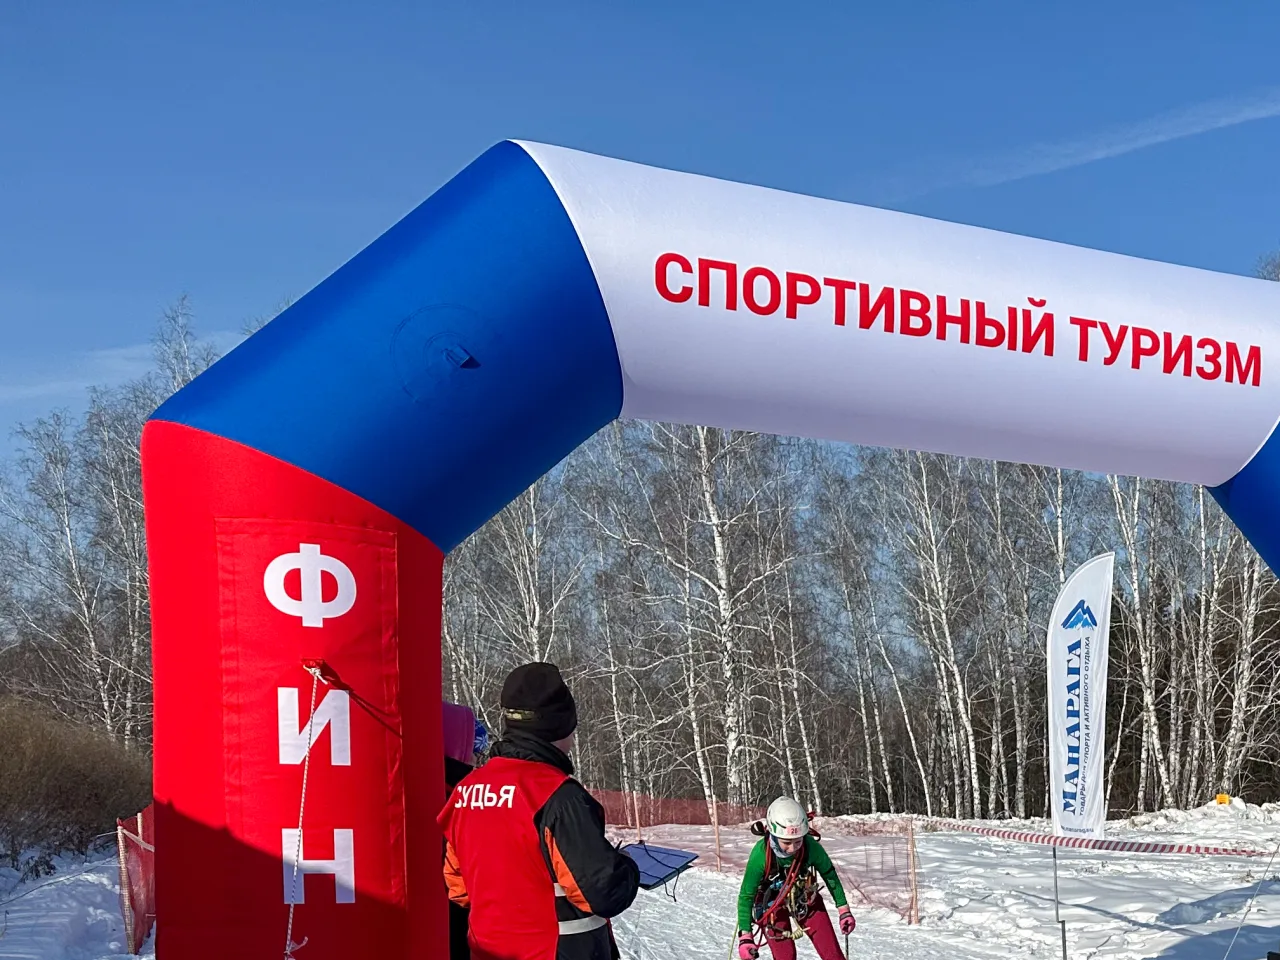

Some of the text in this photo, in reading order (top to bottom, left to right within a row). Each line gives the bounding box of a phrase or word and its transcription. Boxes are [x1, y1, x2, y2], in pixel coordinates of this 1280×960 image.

[654, 252, 1263, 388] СПОРТИВНЫЙ ТУРИЗМ
[1063, 638, 1082, 816] МАНАРАГА
[1083, 673, 1091, 724] АКТИВНОГО
